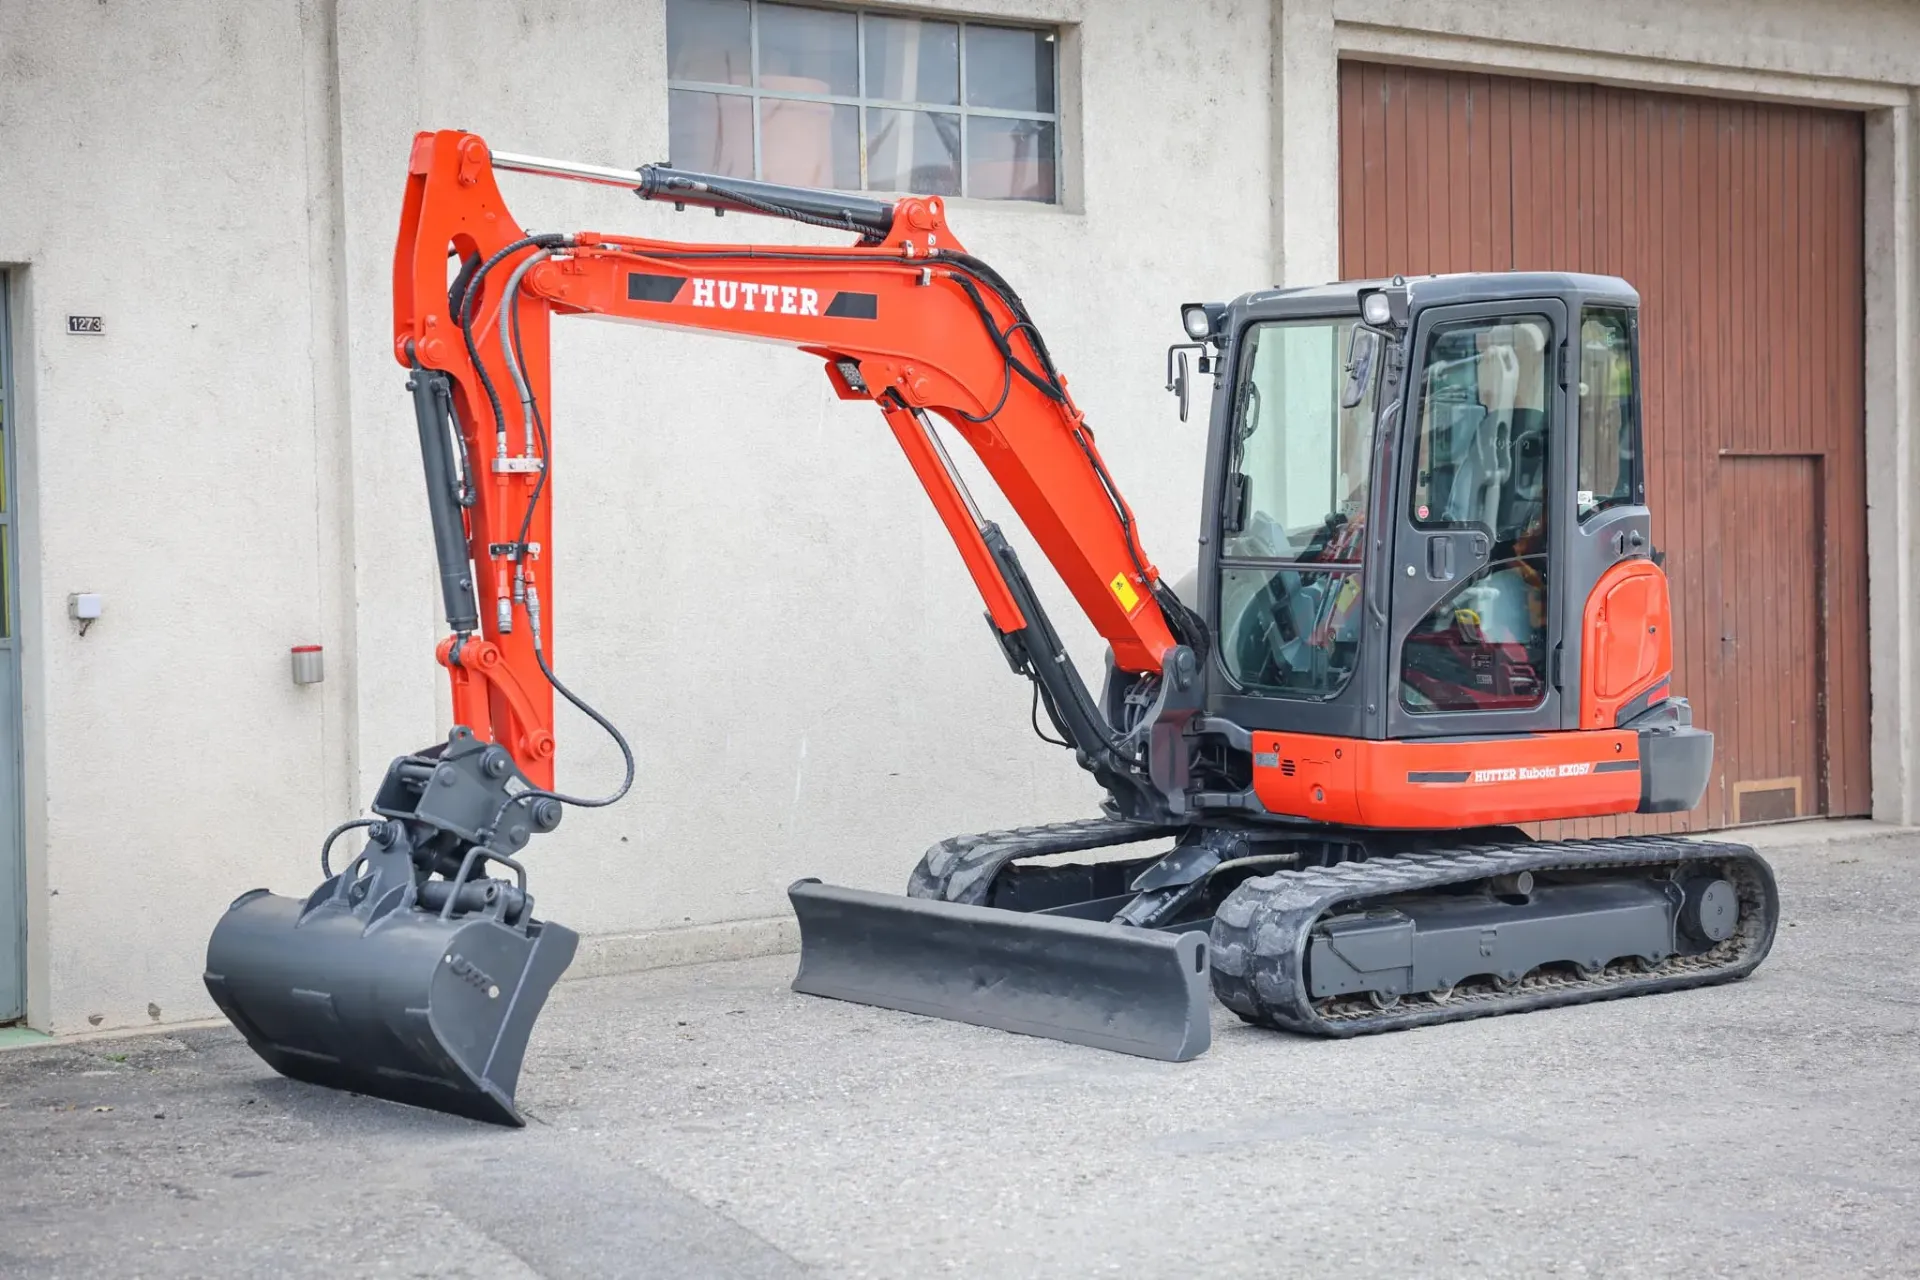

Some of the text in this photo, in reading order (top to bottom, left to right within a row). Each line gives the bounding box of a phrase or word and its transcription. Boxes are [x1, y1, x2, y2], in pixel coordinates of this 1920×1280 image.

[692, 277, 819, 316] HUTTER
[71, 317, 101, 331] 1273
[1474, 763, 1591, 783] HUTTER Kubota KX057
